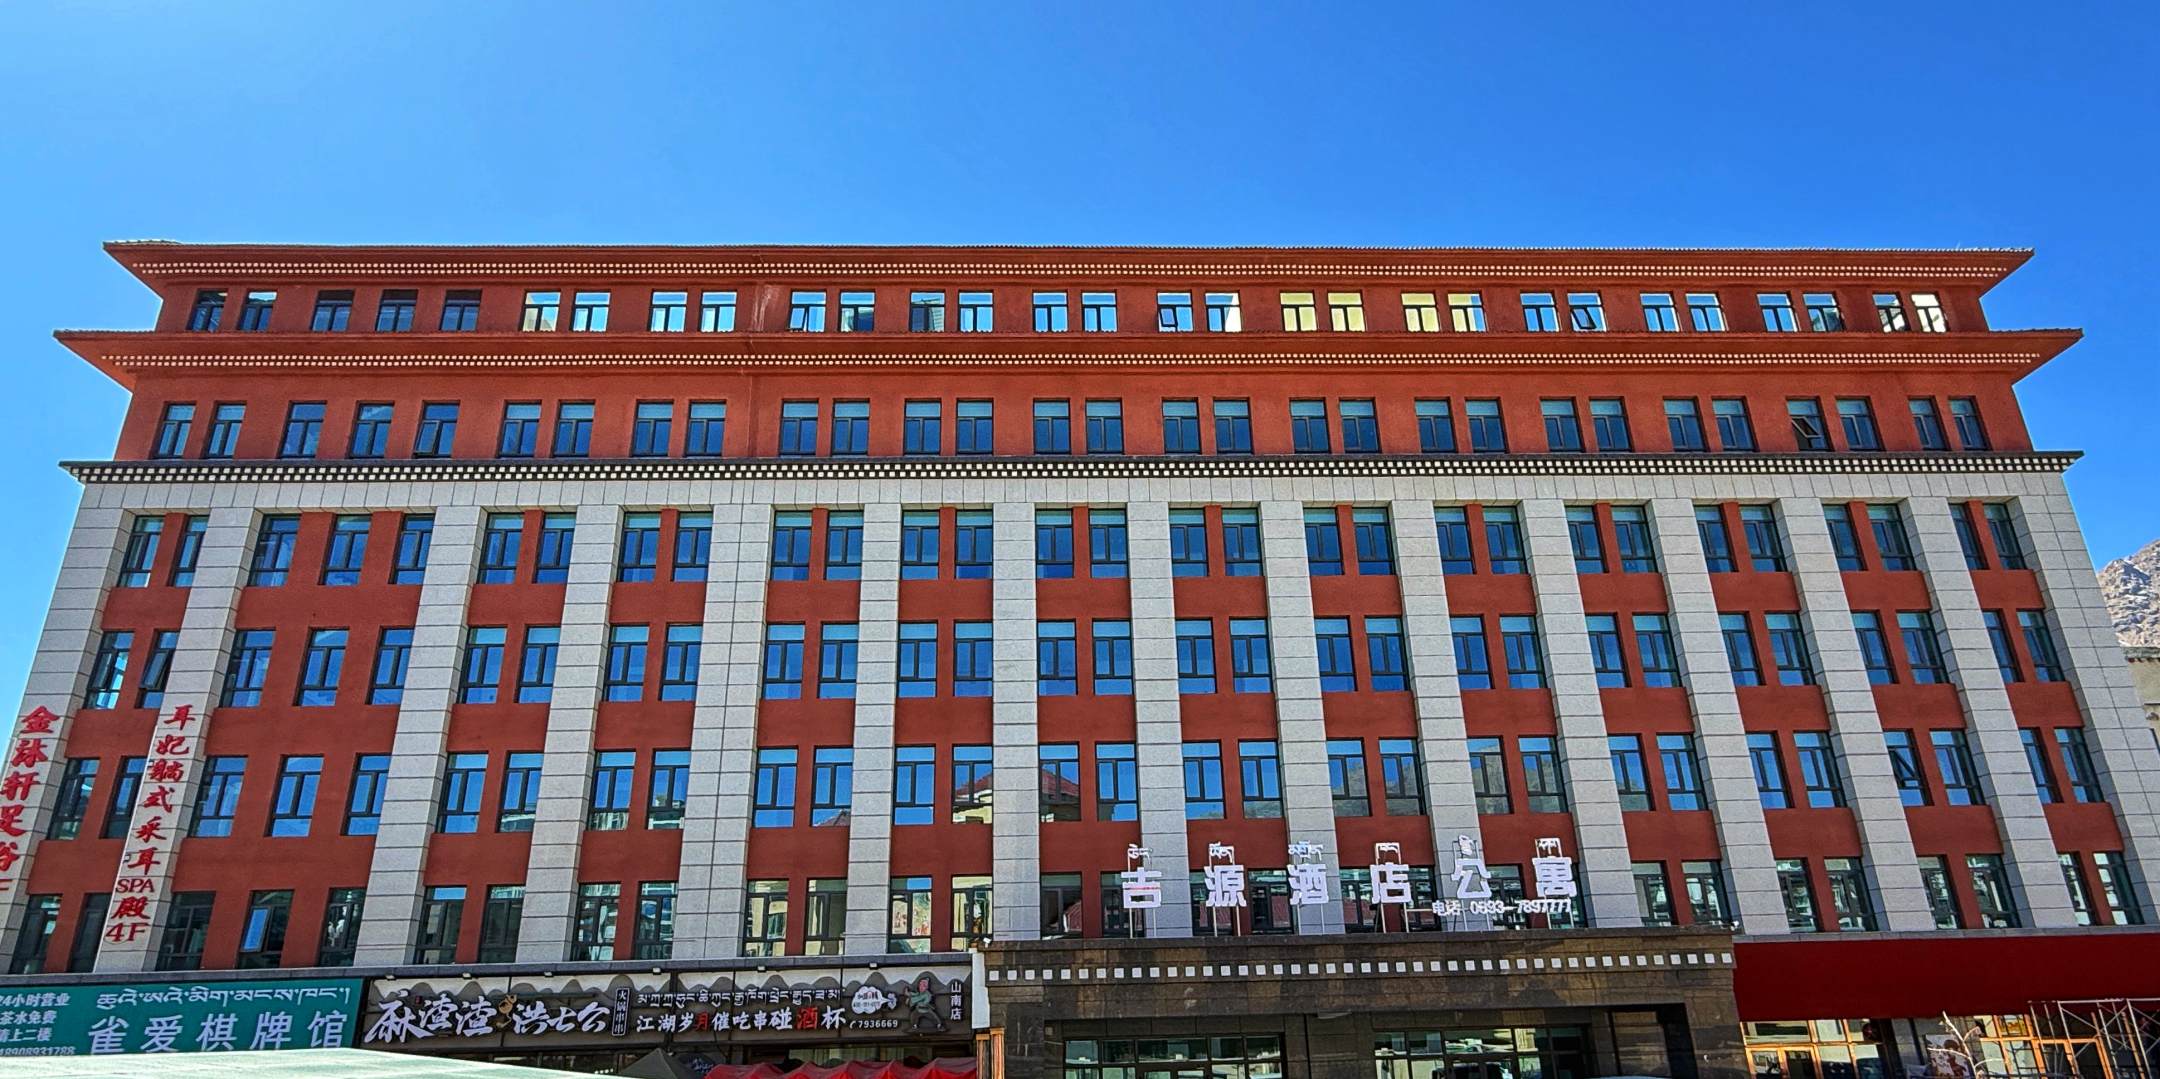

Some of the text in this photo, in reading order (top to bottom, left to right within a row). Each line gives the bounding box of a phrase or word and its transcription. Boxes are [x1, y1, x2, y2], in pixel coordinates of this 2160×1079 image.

[1121, 855, 1577, 909] 吉源酒店公寓
[0, 1010, 57, 1025] 茶水免费
[513, 1000, 611, 1035] 洪七公
[949, 981, 962, 1021] 山南店
[87, 1010, 348, 1055] 雀爱棋牌馆
[636, 1006, 846, 1033] 江湖岁月催吃串碰酒杯
[858, 1019, 898, 1029] 7936669
